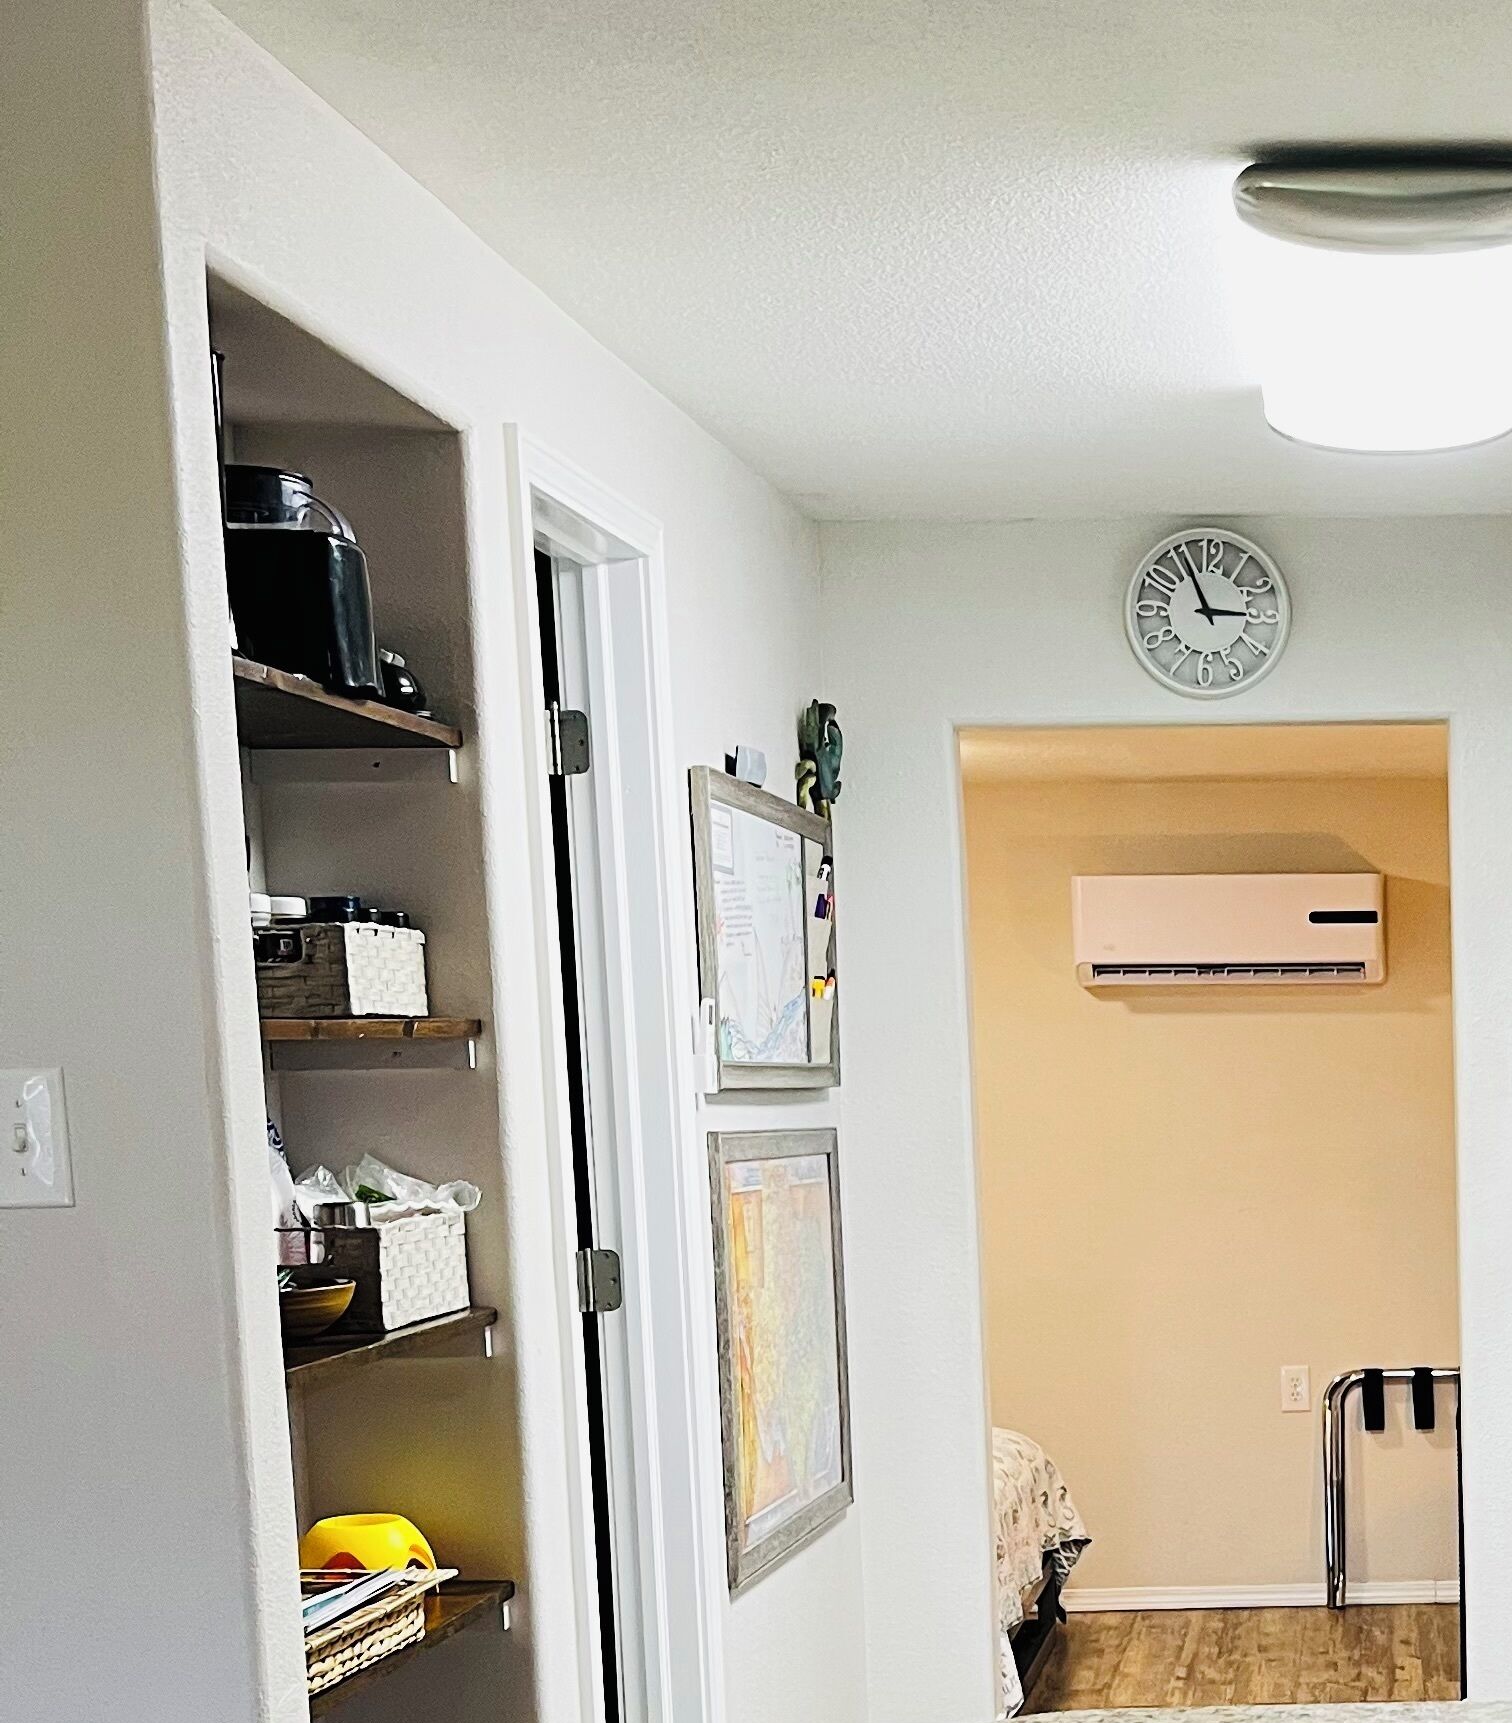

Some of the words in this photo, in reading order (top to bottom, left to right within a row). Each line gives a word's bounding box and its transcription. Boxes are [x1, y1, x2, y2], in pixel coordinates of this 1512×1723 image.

[1168, 543, 1200, 580] 11
[1198, 538, 1224, 574] 12
[1230, 551, 1251, 583] 1
[1144, 564, 1181, 598] 10
[1237, 577, 1272, 603] 2
[1136, 600, 1169, 617] 9
[1247, 607, 1280, 624] 3
[1143, 626, 1174, 649] 8
[1240, 631, 1270, 657] 4
[1171, 642, 1194, 676] 7
[1197, 652, 1213, 687] 6
[1220, 646, 1244, 681] 5
